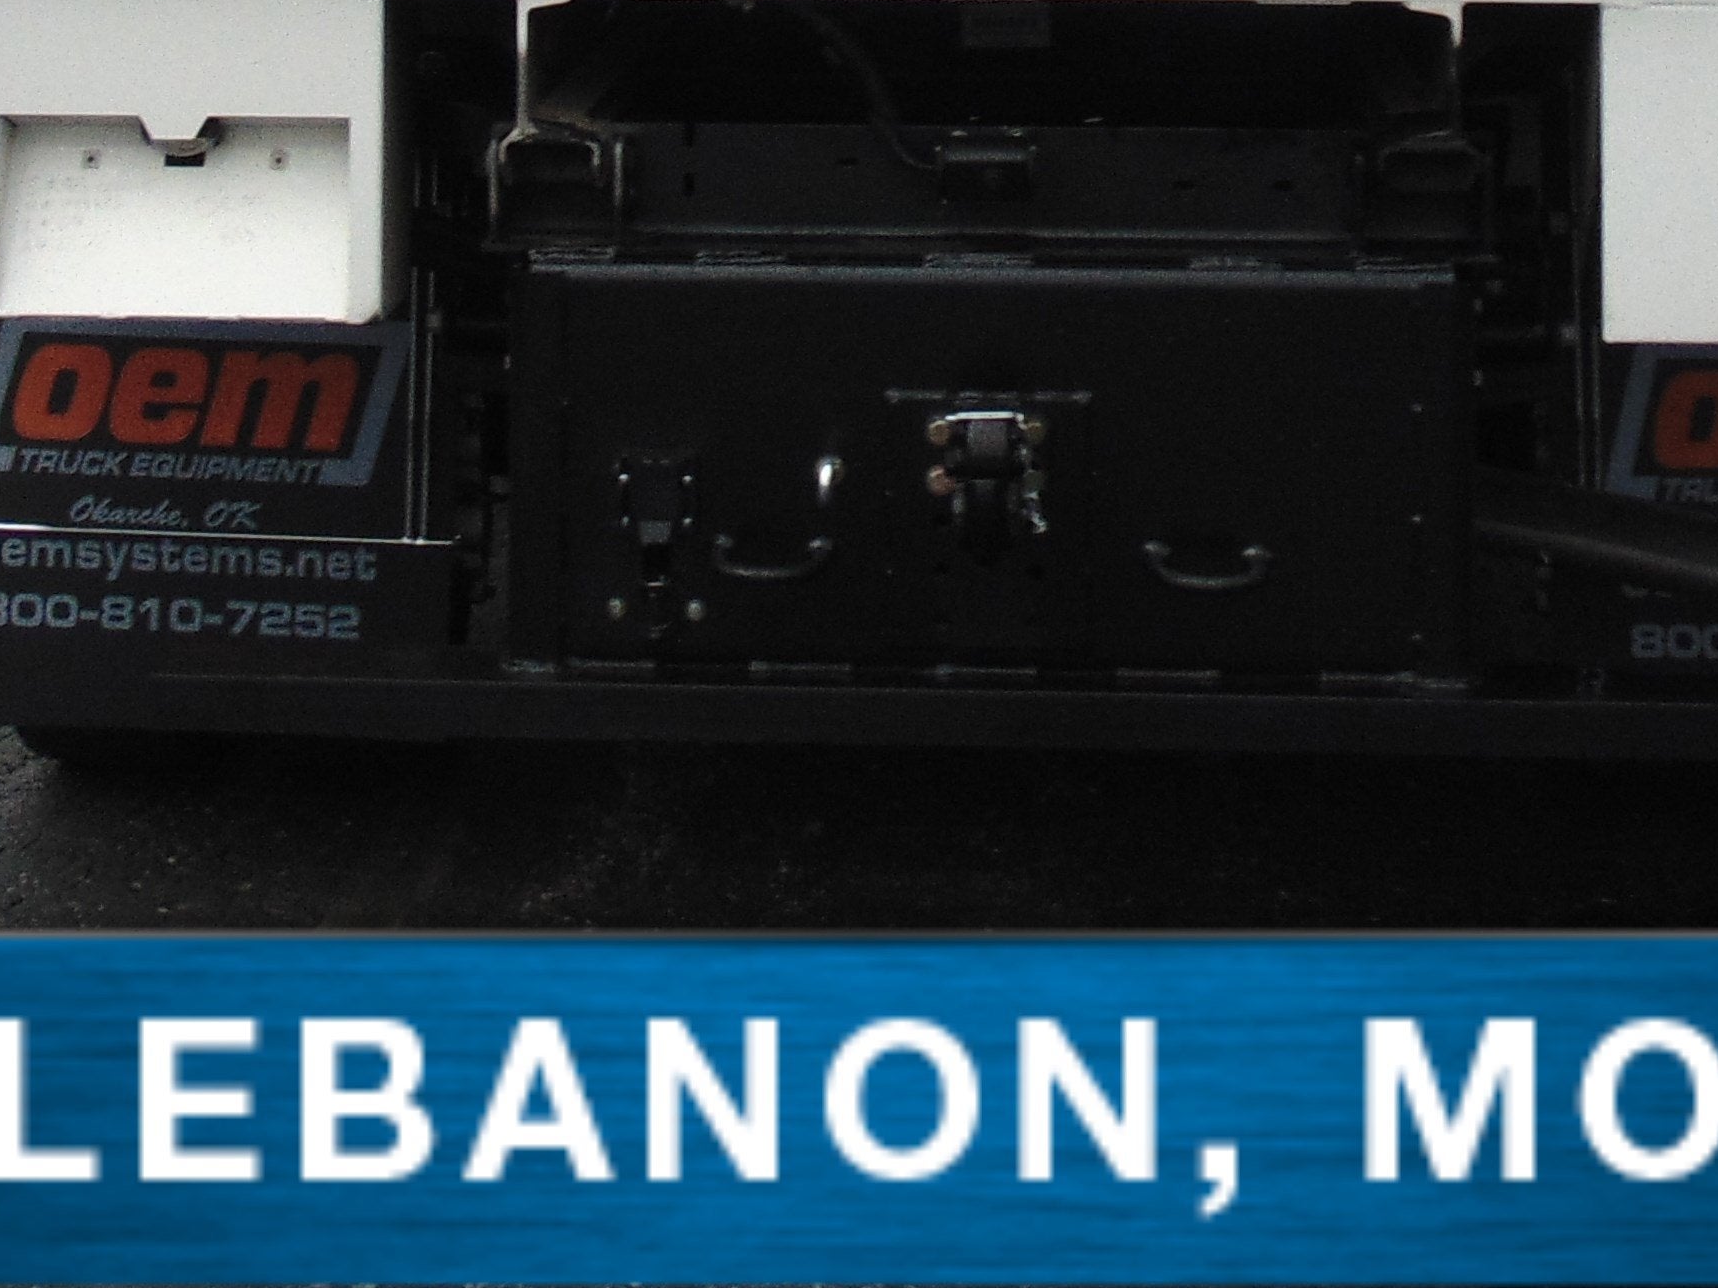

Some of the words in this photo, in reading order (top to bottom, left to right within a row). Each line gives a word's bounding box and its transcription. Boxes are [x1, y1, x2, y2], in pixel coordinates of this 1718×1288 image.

[13, 343, 360, 451] oem
[20, 449, 130, 476] TRUCK
[130, 453, 326, 485] EQUIPMENT
[204, 499, 264, 529] OK
